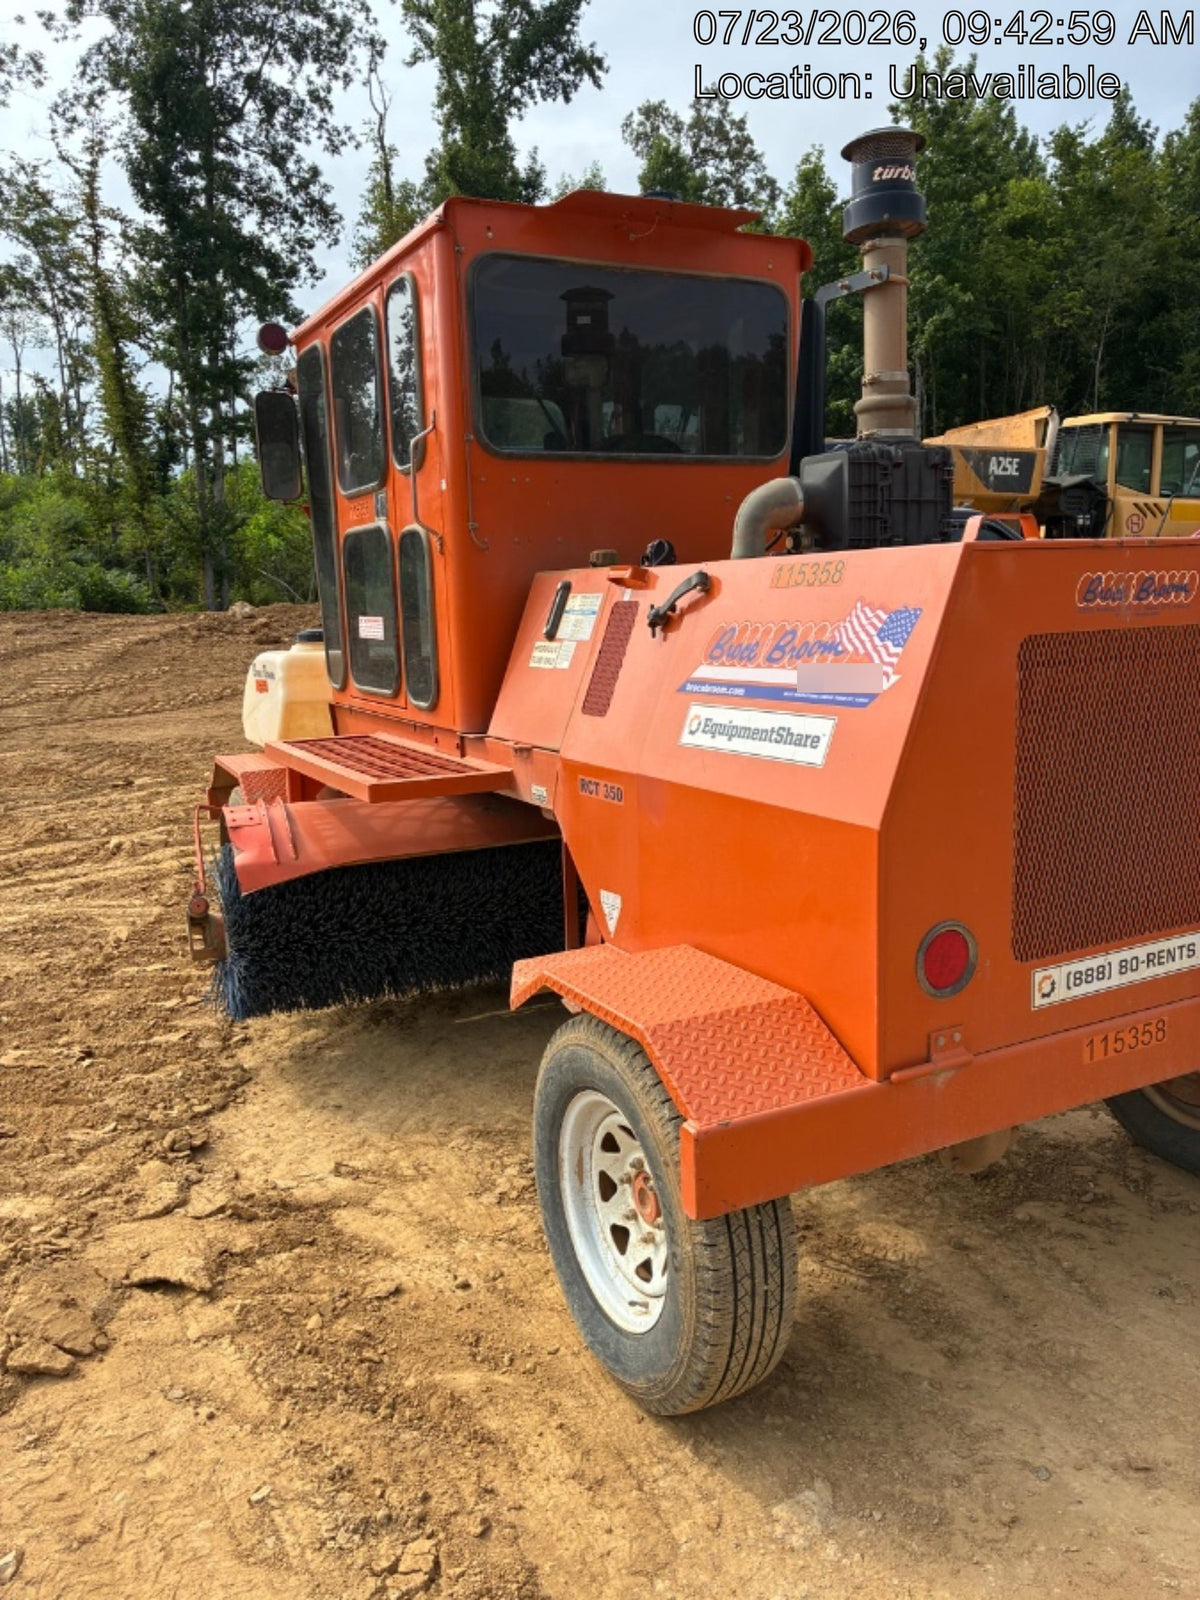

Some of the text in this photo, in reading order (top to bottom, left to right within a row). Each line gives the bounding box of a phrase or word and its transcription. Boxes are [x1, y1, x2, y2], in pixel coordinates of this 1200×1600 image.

[988, 457, 1020, 476] A25E
[774, 560, 846, 587] 115358
[701, 717, 821, 750] EquipmentShare
[579, 778, 623, 803] RCT 350
[1066, 942, 1196, 990] (888) 80-RENTS
[1085, 1018, 1167, 1062] 115358
